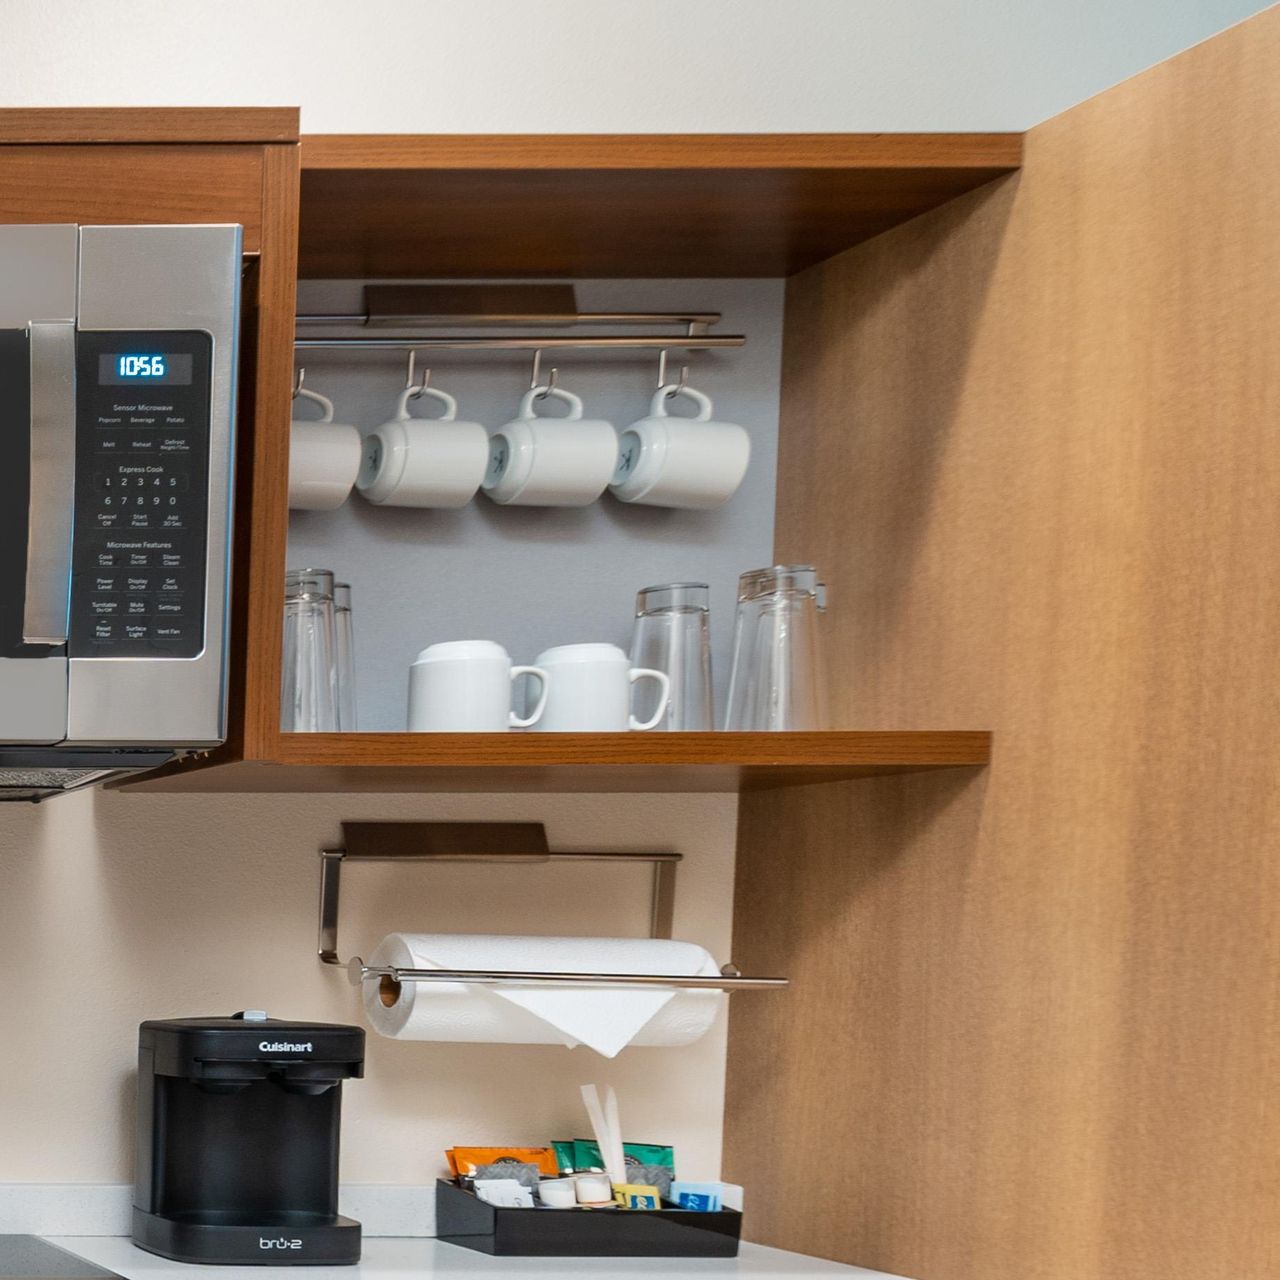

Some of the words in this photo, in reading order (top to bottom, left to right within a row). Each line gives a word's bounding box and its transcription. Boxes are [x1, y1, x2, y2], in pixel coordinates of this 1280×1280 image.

[119, 466, 145, 474] Express
[105, 497, 111, 505] 6
[121, 497, 127, 505] 7
[137, 497, 144, 505] 8
[153, 497, 160, 505] 9
[170, 497, 176, 505] 0
[259, 1041, 313, 1053] Cuisinart
